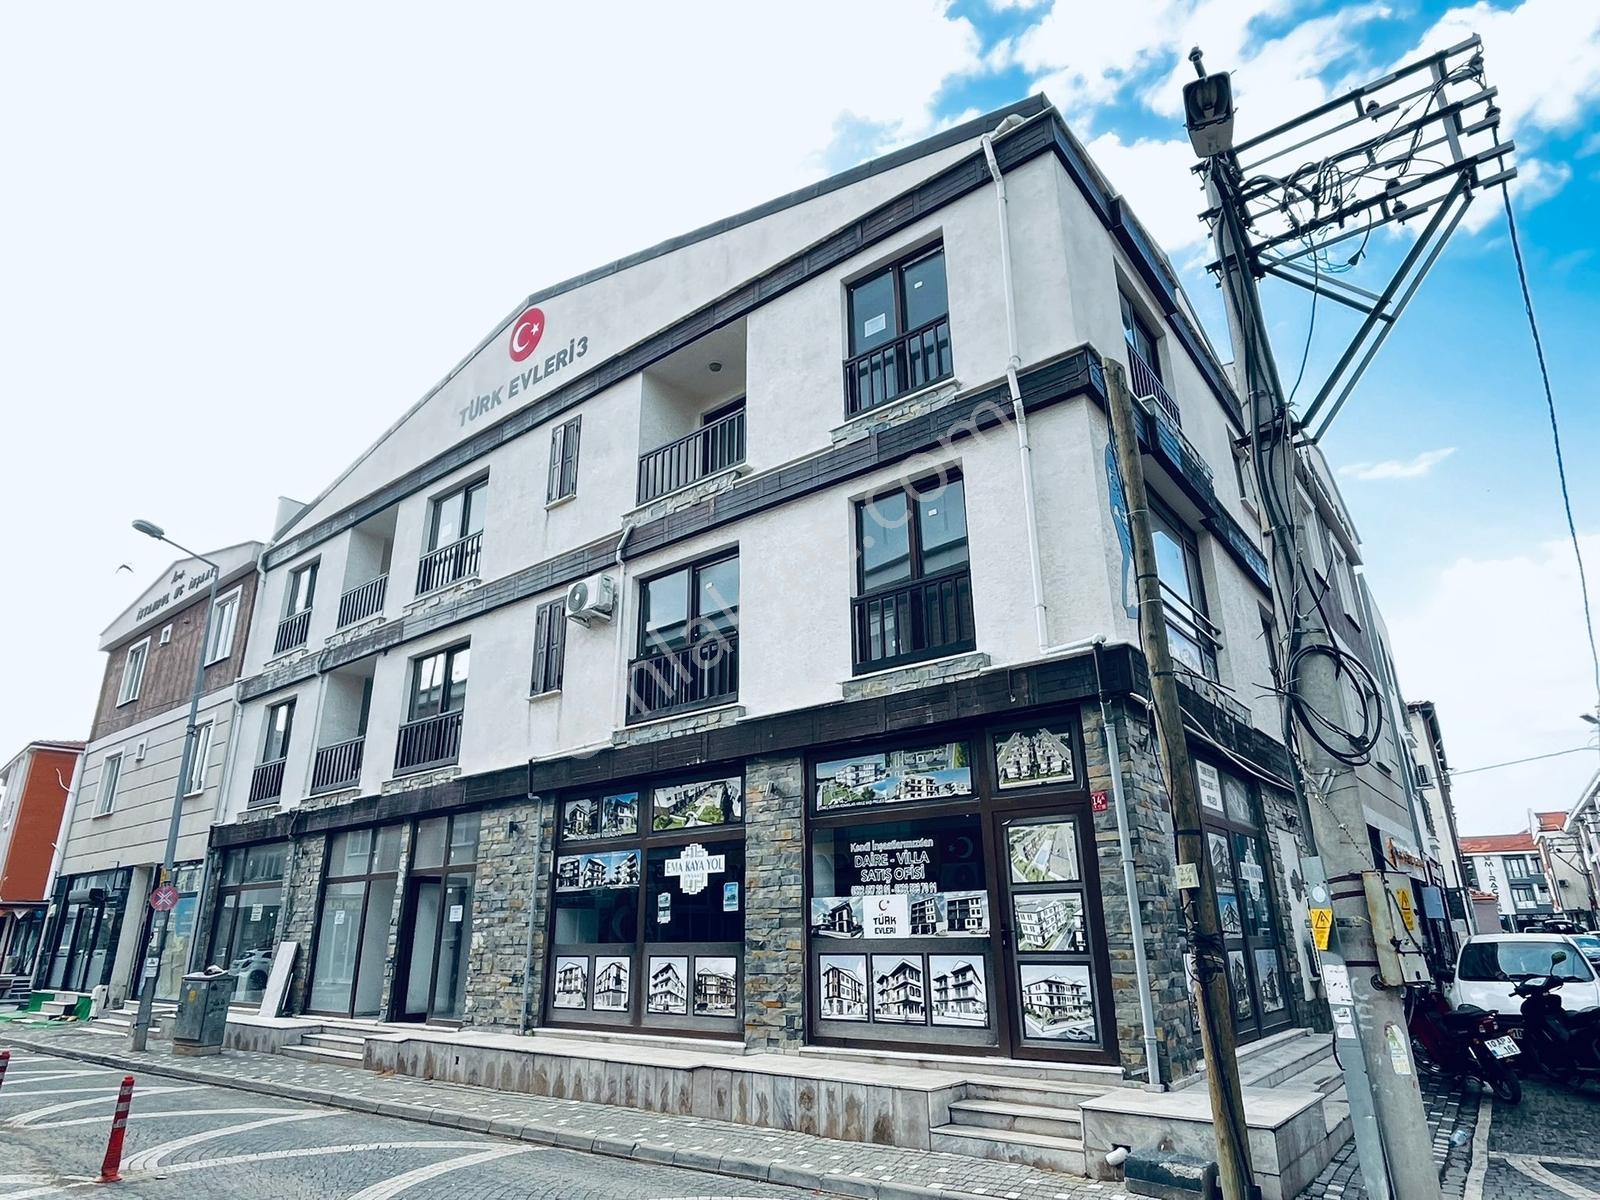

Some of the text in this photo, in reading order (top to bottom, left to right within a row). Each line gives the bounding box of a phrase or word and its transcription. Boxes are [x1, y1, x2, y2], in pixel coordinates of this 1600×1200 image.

[458, 337, 588, 427] TÜRK EVLERİ 3
[685, 859, 705, 872] KAYA
[707, 857, 723, 871] YOL
[854, 851, 888, 868] DAİRE
[896, 849, 930, 865] VİLLA
[860, 863, 925, 884] SATIŞ OFİSİ
[873, 913, 897, 926] TÜRK
